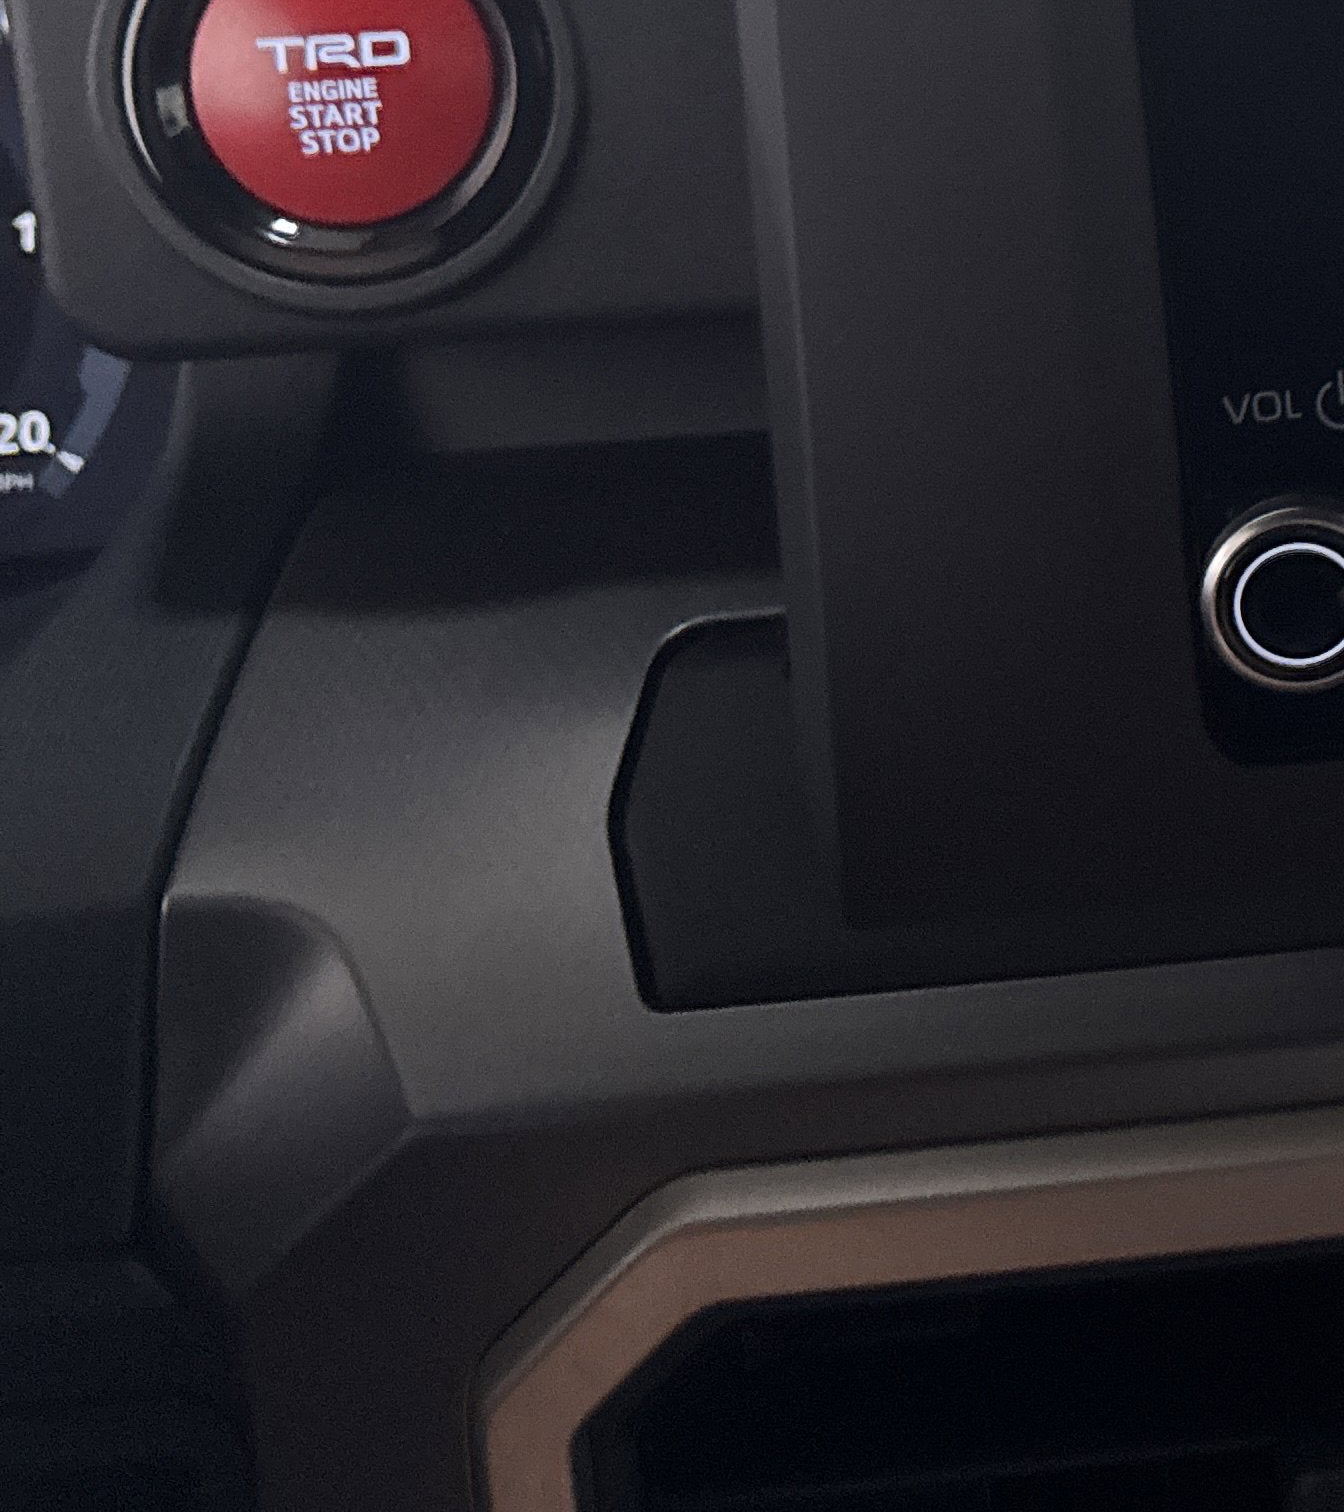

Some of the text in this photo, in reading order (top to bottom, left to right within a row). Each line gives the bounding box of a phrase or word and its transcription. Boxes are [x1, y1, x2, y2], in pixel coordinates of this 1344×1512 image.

[255, 29, 411, 75] TRD
[287, 76, 379, 103] ENGINE
[288, 99, 384, 129] START
[299, 125, 380, 157] STOP
[1221, 388, 1305, 426] VOL
